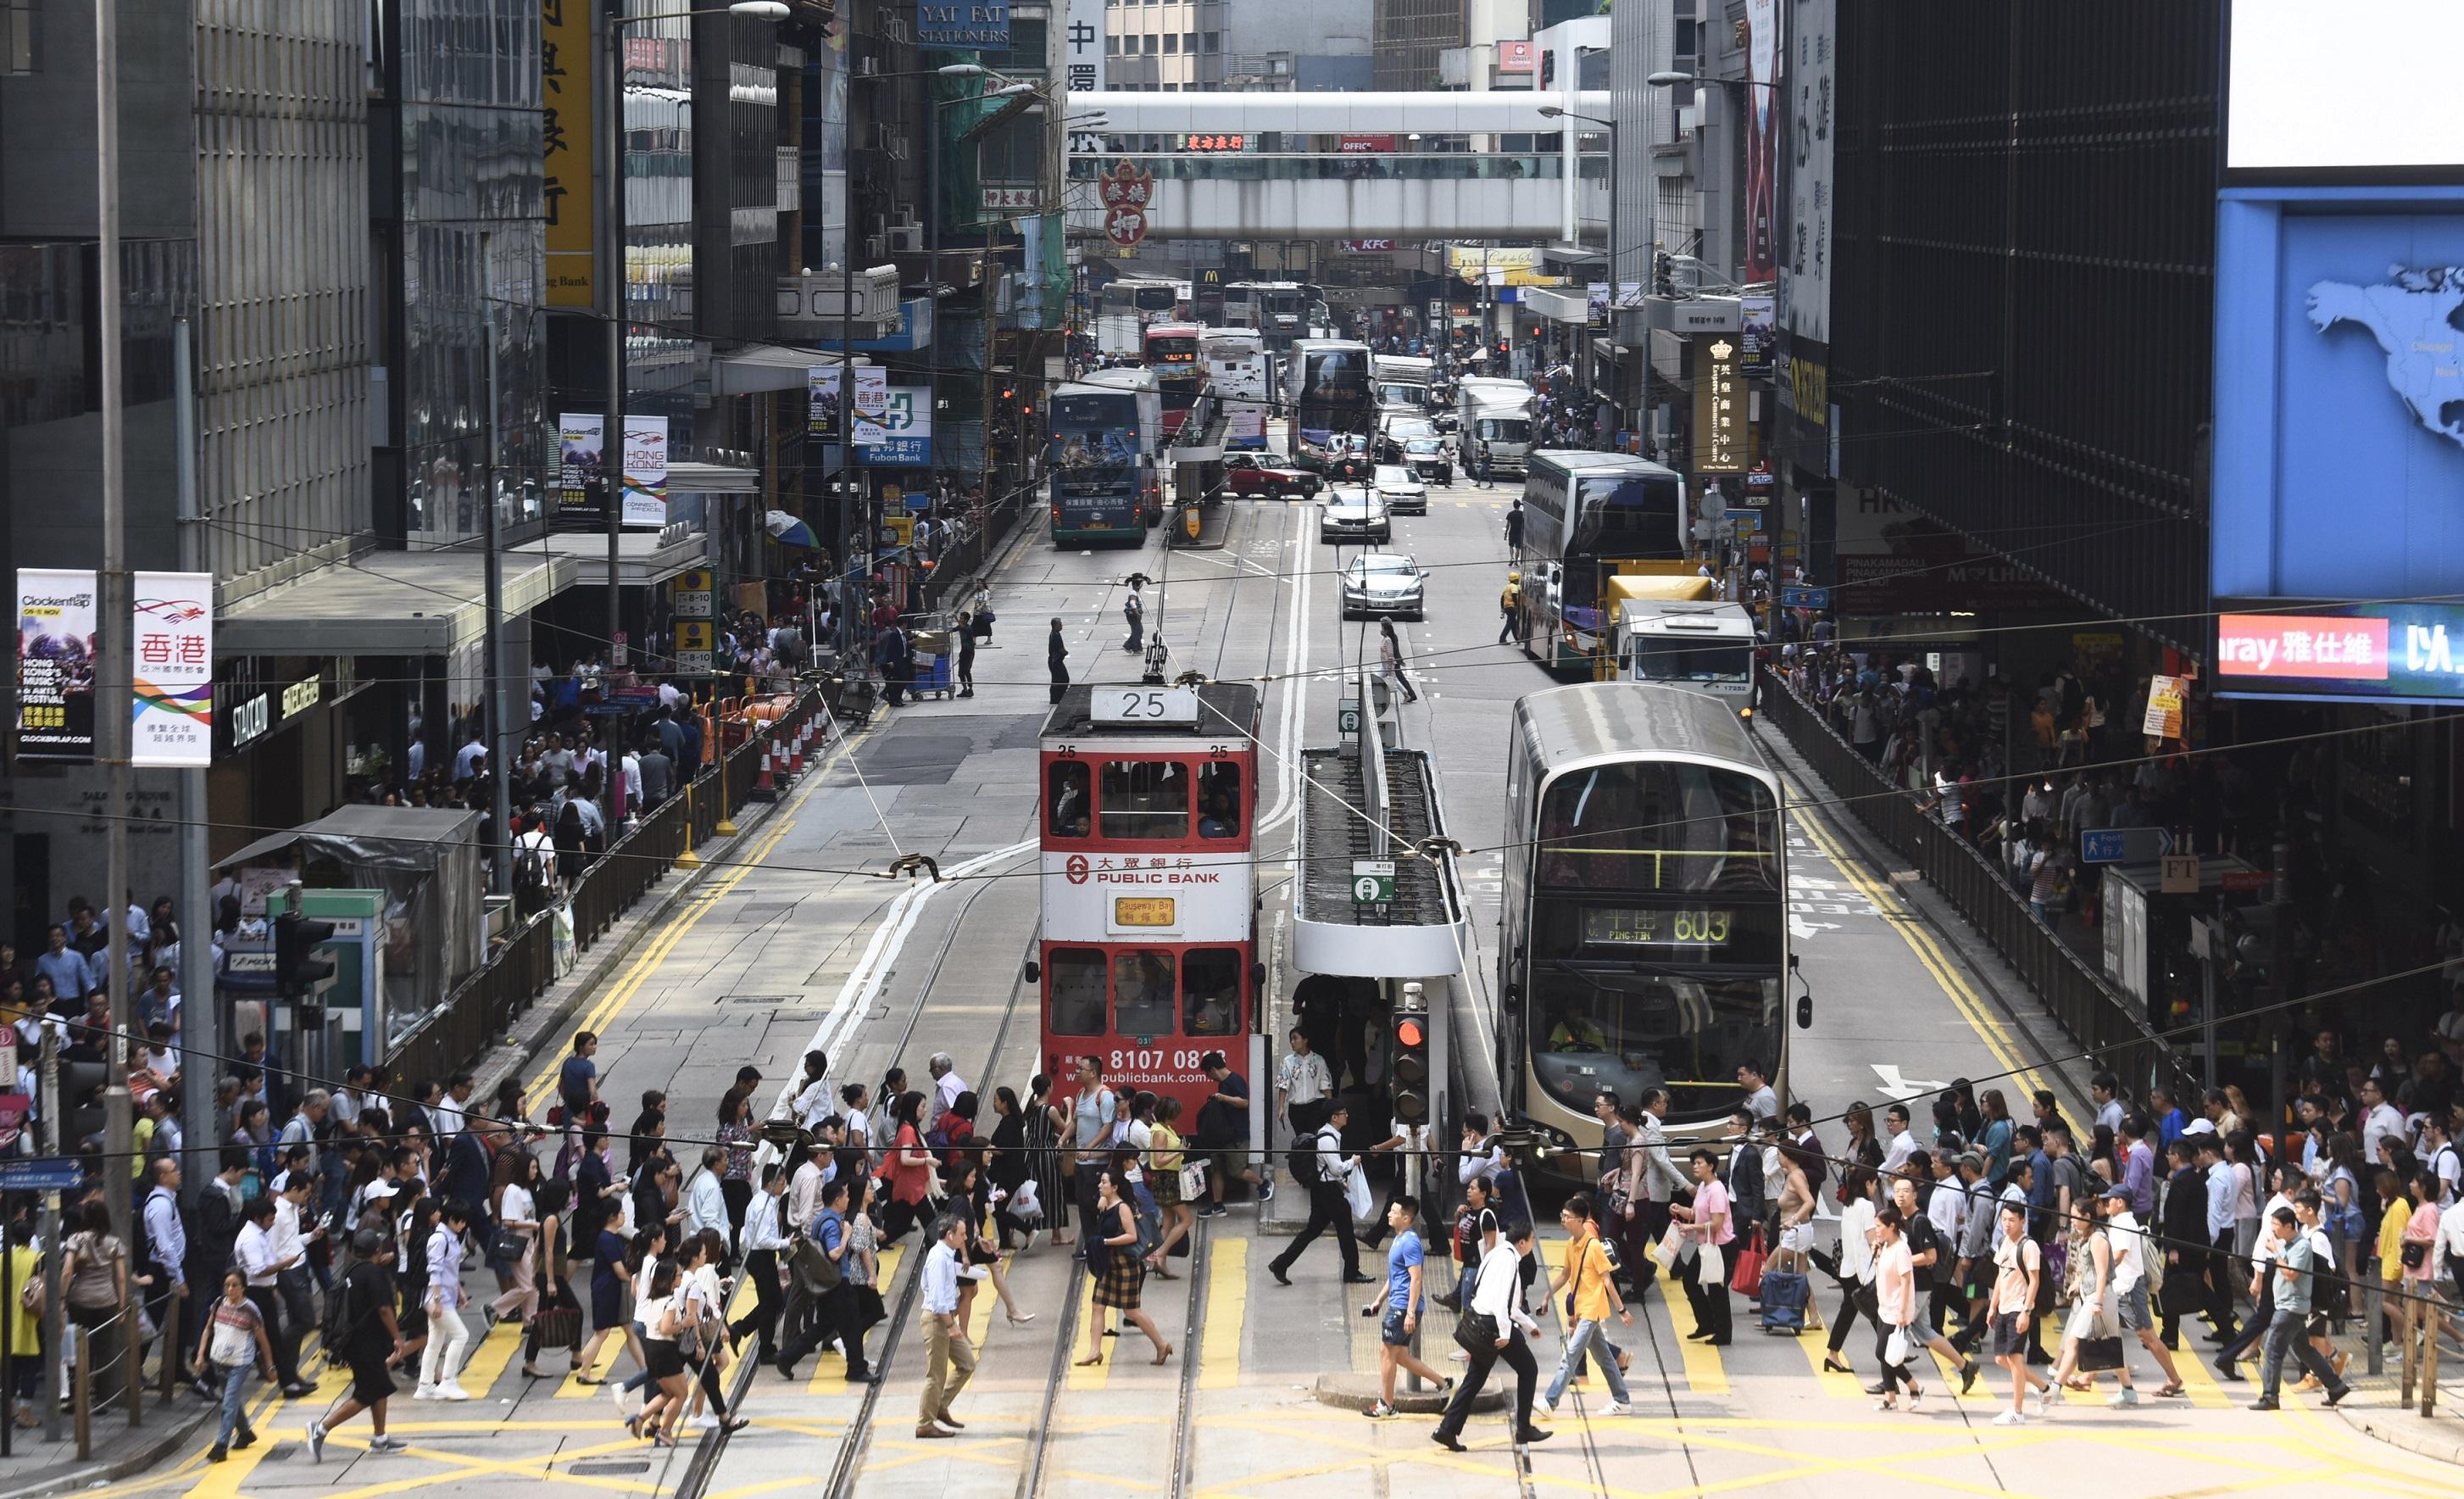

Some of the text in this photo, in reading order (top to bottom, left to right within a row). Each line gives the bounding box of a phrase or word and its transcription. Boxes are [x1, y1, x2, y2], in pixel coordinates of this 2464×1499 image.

[922, 6, 959, 22] YAT
[918, 31, 1009, 42] STATIONERS
[1362, 239, 1389, 249] KFC
[559, 276, 589, 287] Bank
[858, 392, 884, 404] 香港
[1720, 365, 1731, 463] 英皇商業中心
[562, 427, 600, 436] Clockenflap
[626, 450, 664, 460] HONG
[898, 454, 921, 462] Bank
[626, 460, 664, 470] KONG
[22, 595, 90, 609] Clockenflap
[141, 633, 205, 664] 香港
[2283, 631, 2372, 665] 雅仕維
[24, 659, 54, 668] HONG
[24, 668, 62, 677] KONG'S
[141, 666, 205, 674] 亞洲國際都會
[24, 677, 55, 686] MUSIC
[23, 695, 65, 705] FESTIVAL
[1121, 693, 1165, 718] 25
[20, 734, 92, 744] CLOCKENFLAP.COM
[1059, 744, 1076, 758] 25
[1210, 744, 1228, 758] 25
[2166, 860, 2197, 878] FT
[1098, 873, 1220, 883] PUBLIC BANK
[1118, 901, 1173, 912] Causeway Bay
[1125, 912, 1168, 922] 銅鑼灣
[1674, 911, 1727, 941] 603
[1111, 1050, 1164, 1069] 8107
[1, 1050, 10, 1083] Central
